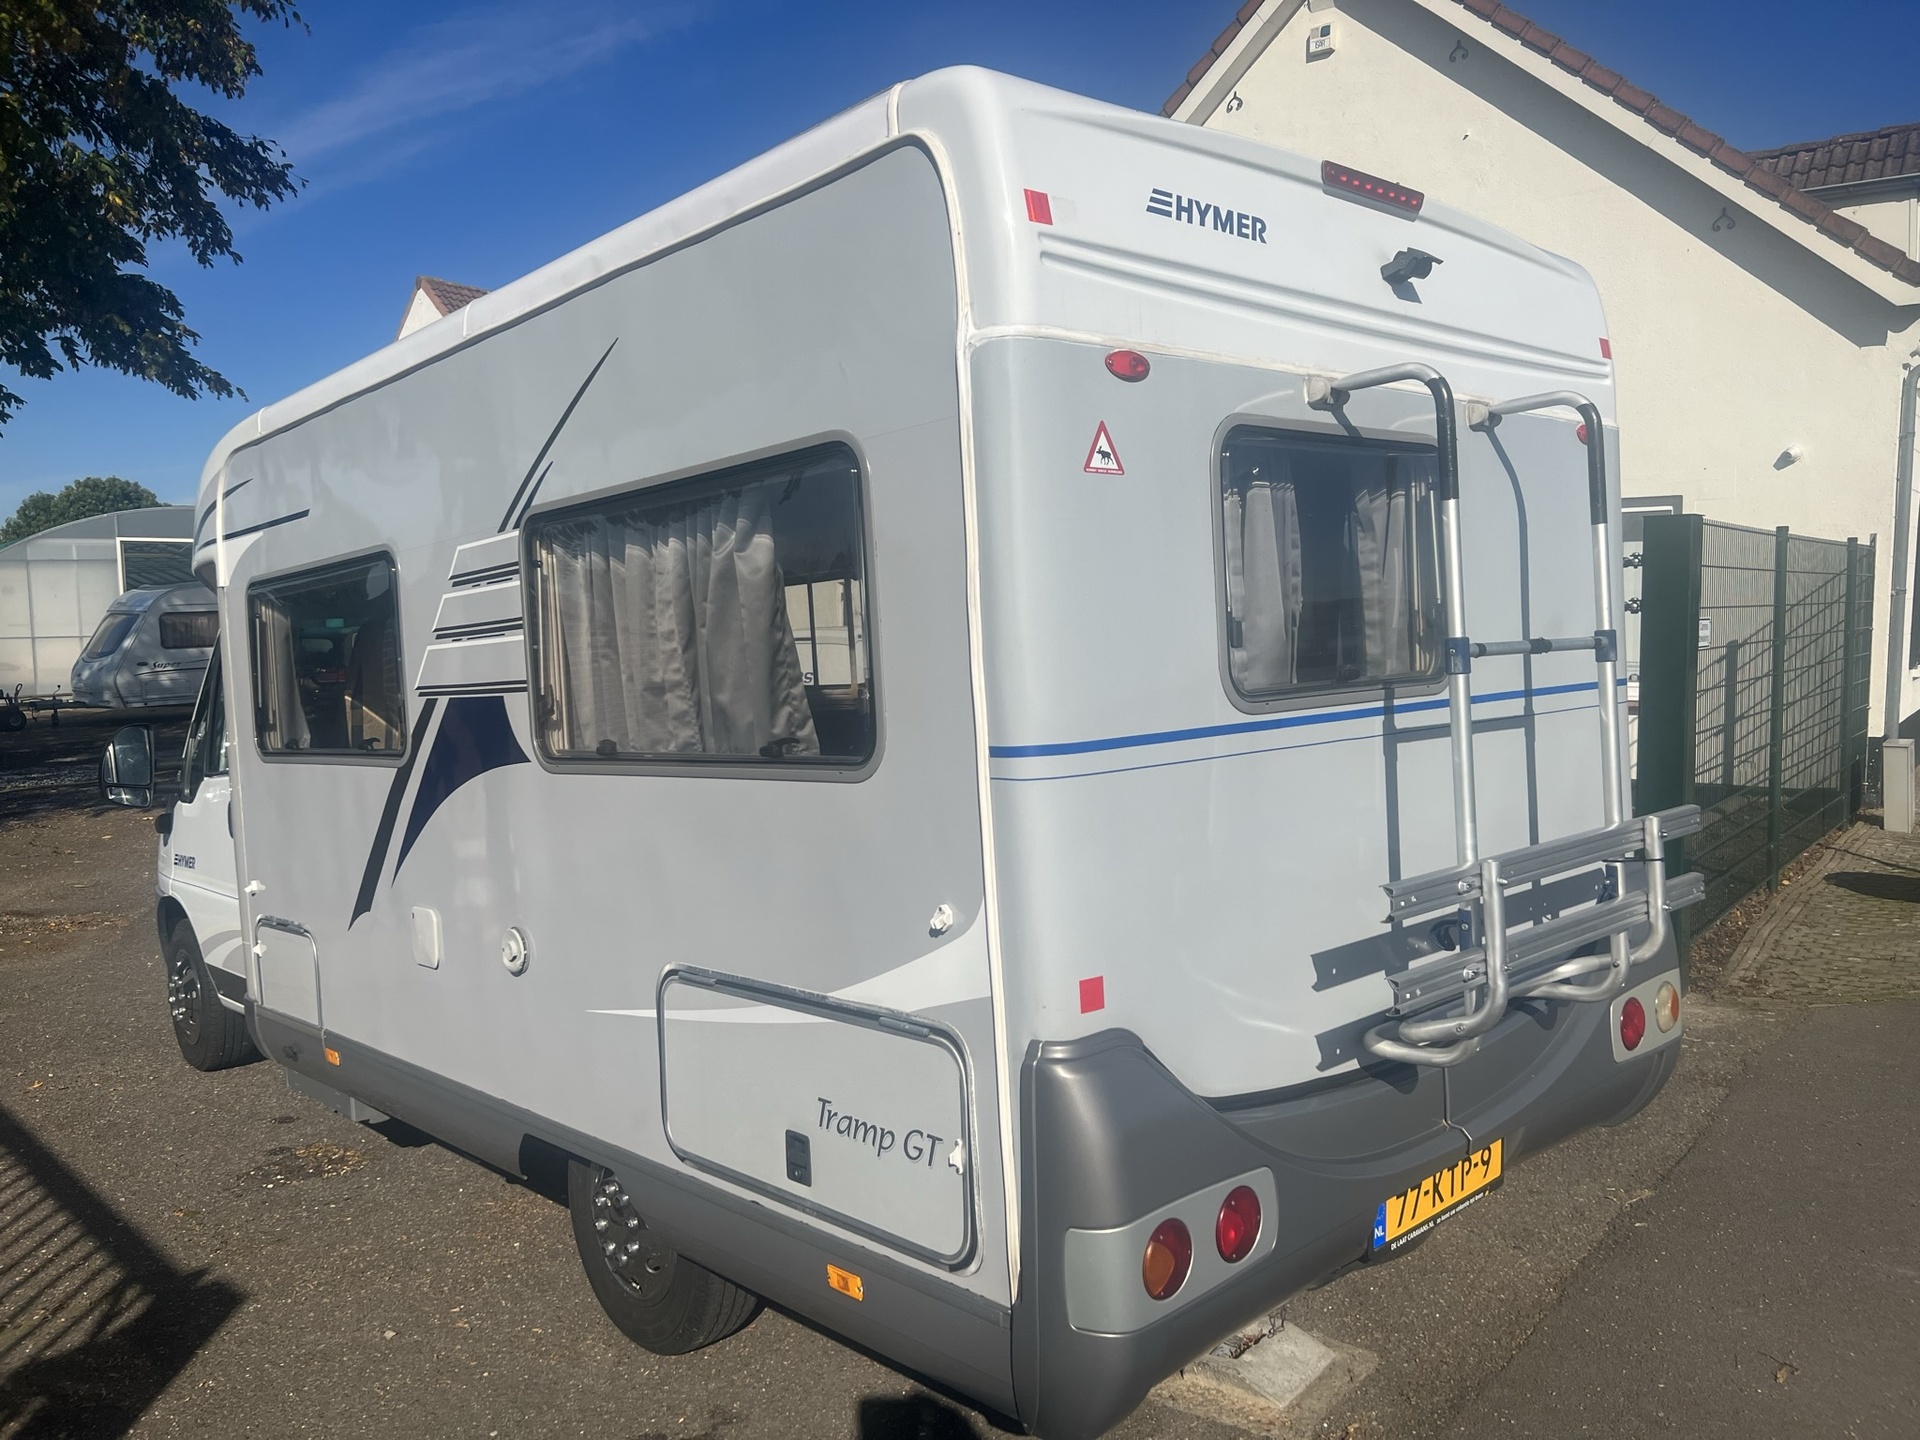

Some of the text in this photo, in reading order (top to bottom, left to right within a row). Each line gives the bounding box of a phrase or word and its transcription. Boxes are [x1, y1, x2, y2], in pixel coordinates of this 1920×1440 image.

[1175, 194, 1268, 245] HYMER
[151, 661, 183, 669] Super
[817, 1096, 944, 1168] Tramp GT
[1396, 1144, 1492, 1229] 77-KTP-9
[1374, 1225, 1385, 1239] NL
